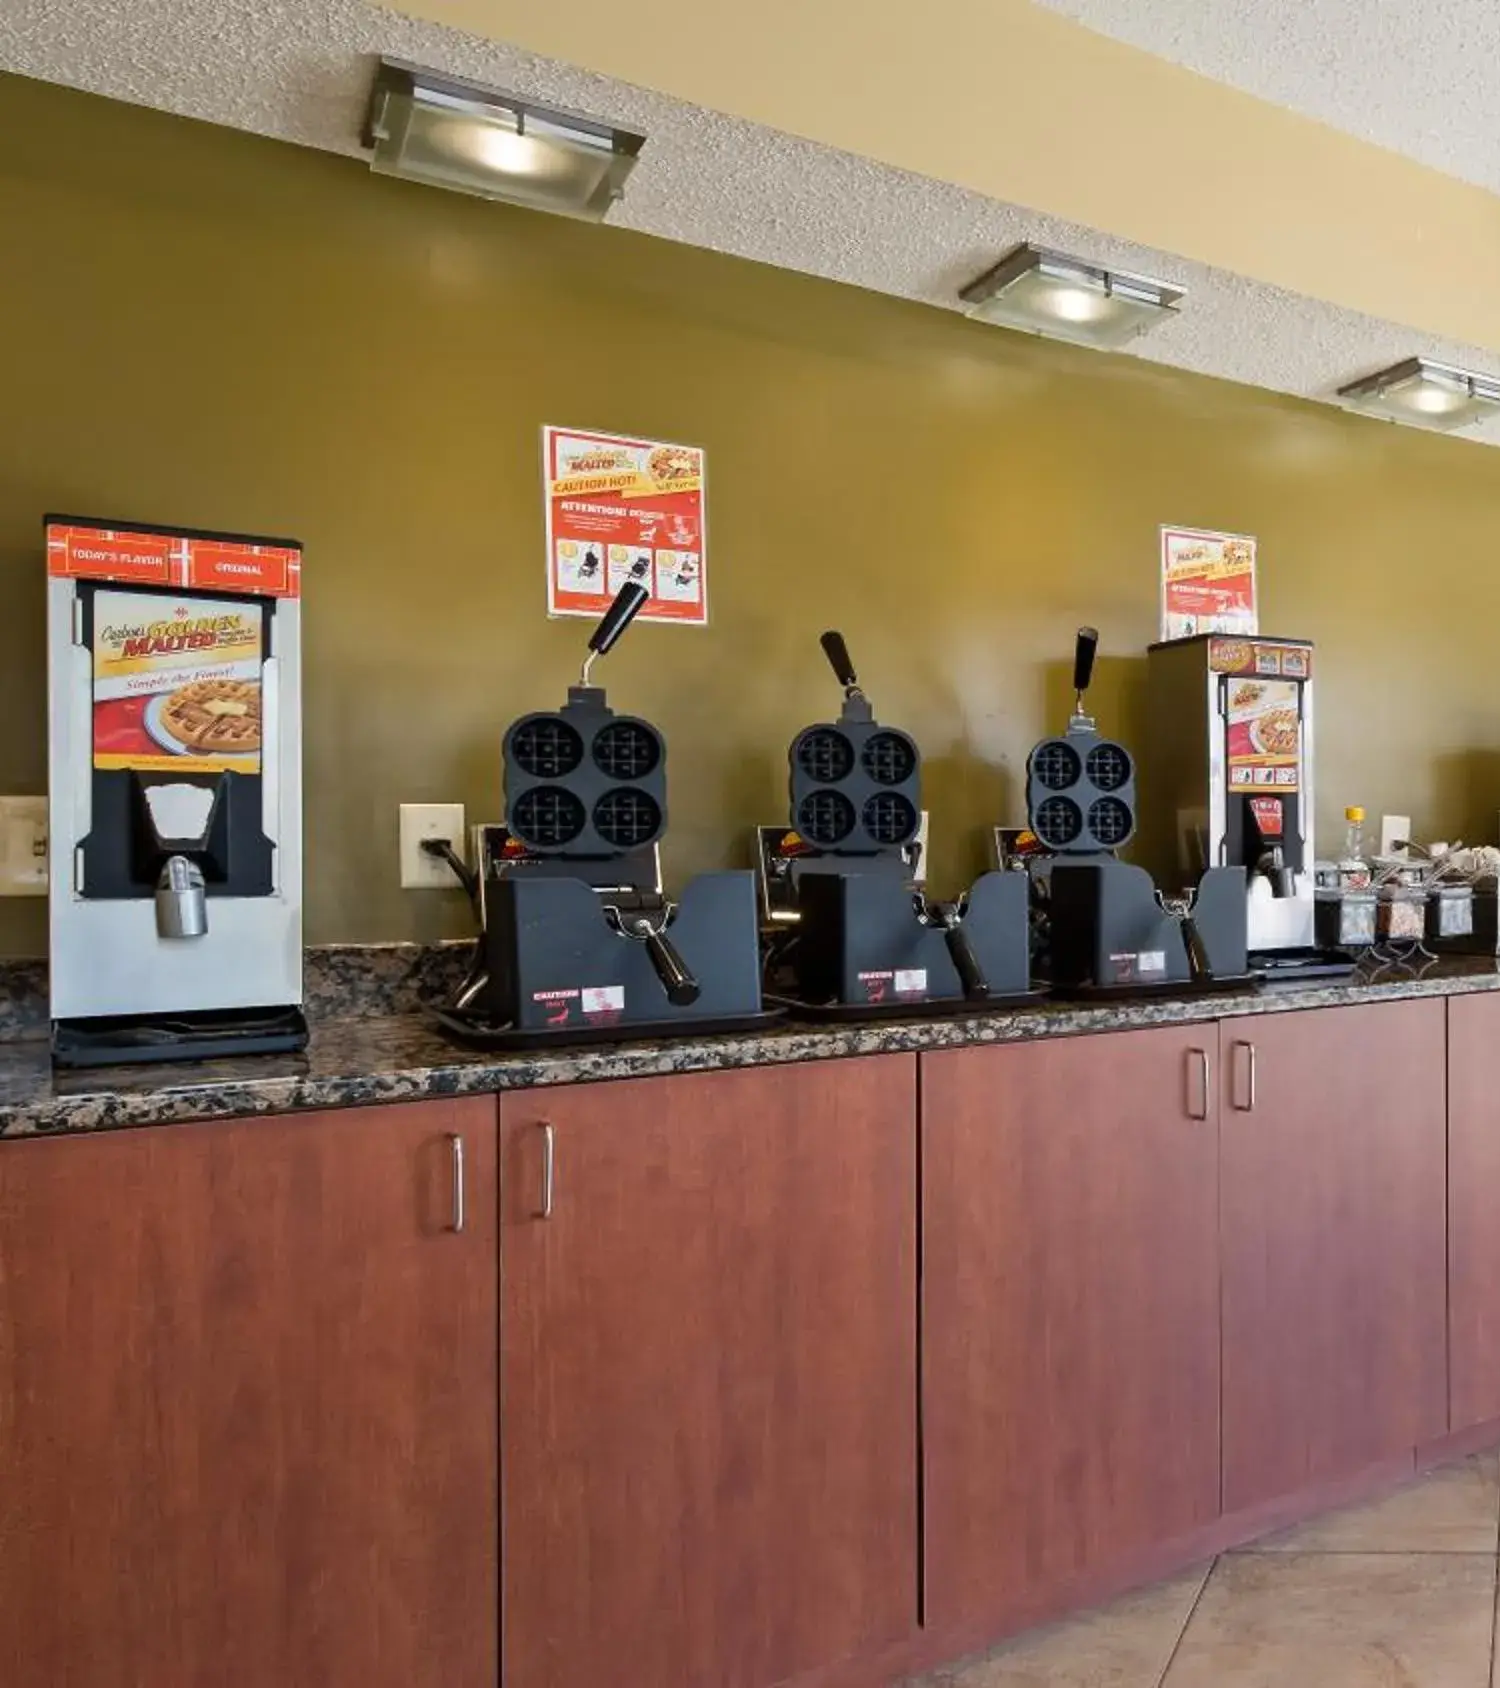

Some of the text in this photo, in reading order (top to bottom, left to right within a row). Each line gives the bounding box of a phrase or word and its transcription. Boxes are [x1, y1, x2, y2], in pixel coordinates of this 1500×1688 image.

[553, 476, 607, 493] CAUTION
[72, 548, 163, 567] TODAY'S FLAVOR
[121, 630, 218, 658] MALTED
[127, 676, 168, 690] Simply
